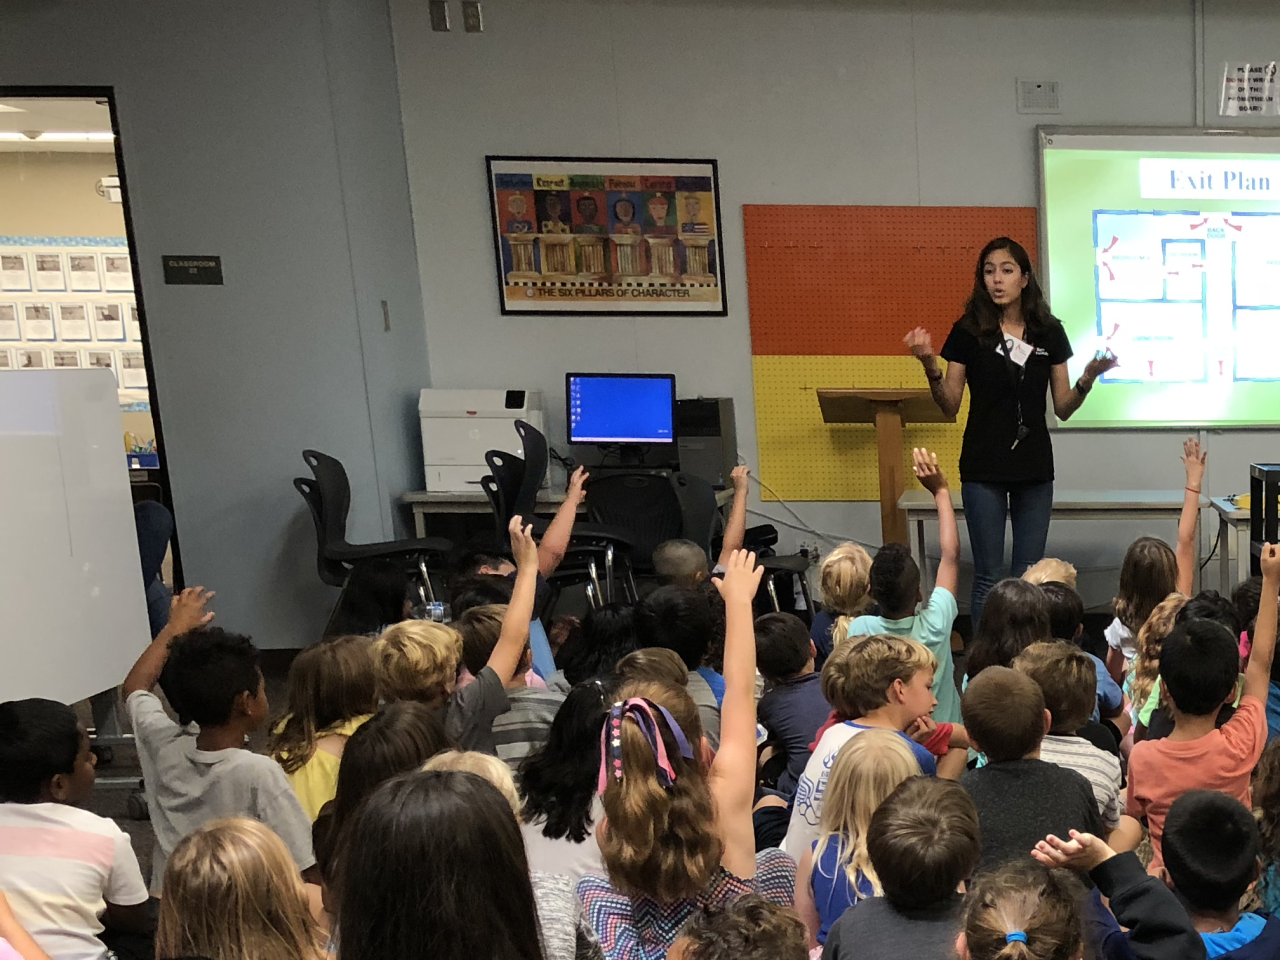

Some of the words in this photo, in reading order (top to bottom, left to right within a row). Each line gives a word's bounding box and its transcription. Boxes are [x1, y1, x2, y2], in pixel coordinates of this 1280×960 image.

[1170, 170, 1213, 189] Exit
[1223, 171, 1270, 190] Plan
[538, 288, 557, 297] THE
[557, 288, 574, 297] SIX
[575, 288, 615, 297] PILLARS
[616, 289, 630, 297] OF
[631, 288, 690, 298] CHARACTER
